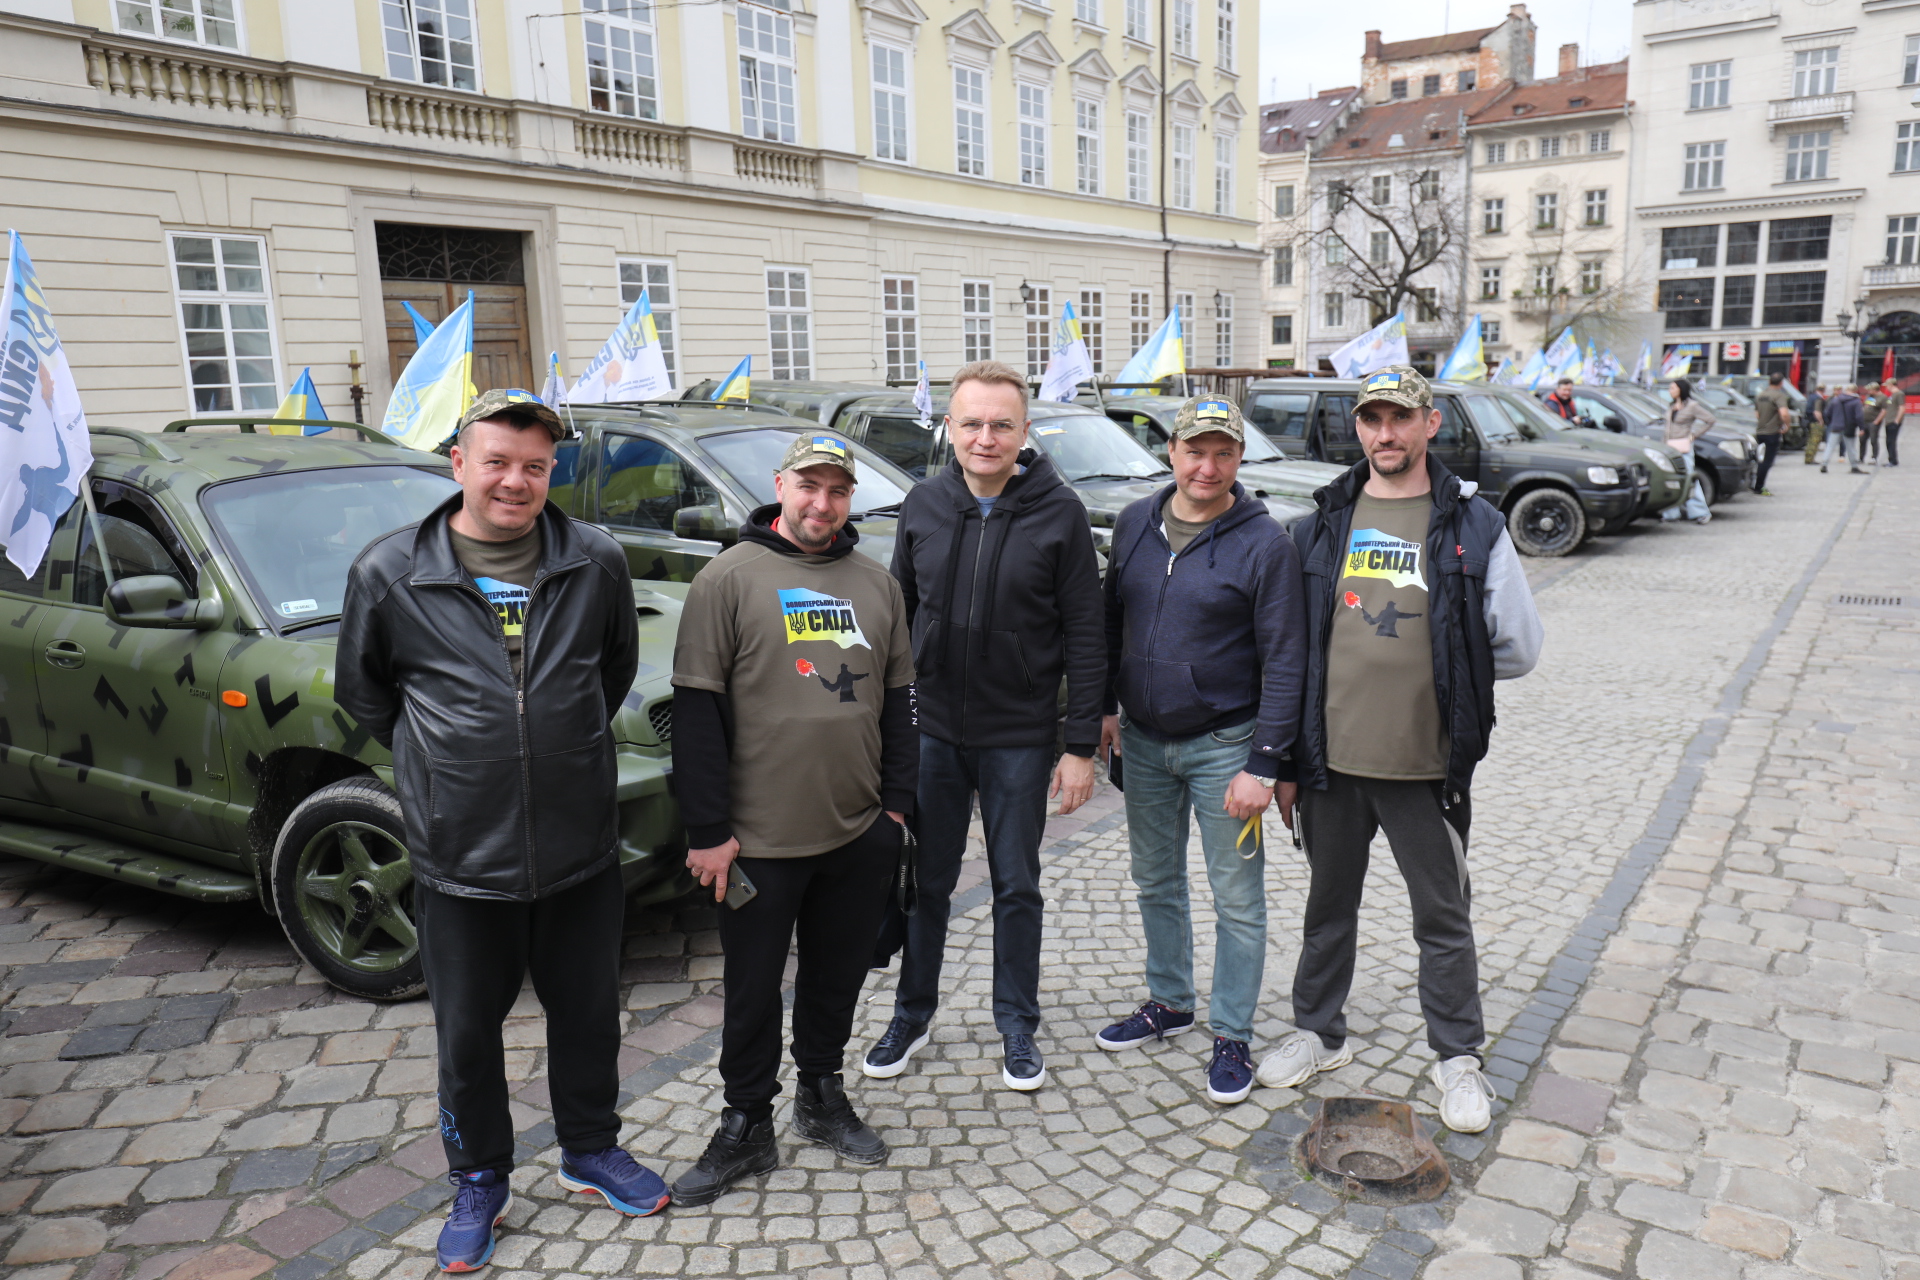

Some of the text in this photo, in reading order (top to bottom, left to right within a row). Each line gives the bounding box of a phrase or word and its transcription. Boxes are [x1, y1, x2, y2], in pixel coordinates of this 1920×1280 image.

[1354, 540, 1400, 548] ВОЛОНТЕРСЬКИЙ
[1368, 549, 1416, 574] СХІД
[785, 599, 834, 608] ВОЛОНТЕРСЬКИЙ
[808, 609, 856, 633] СХІД
